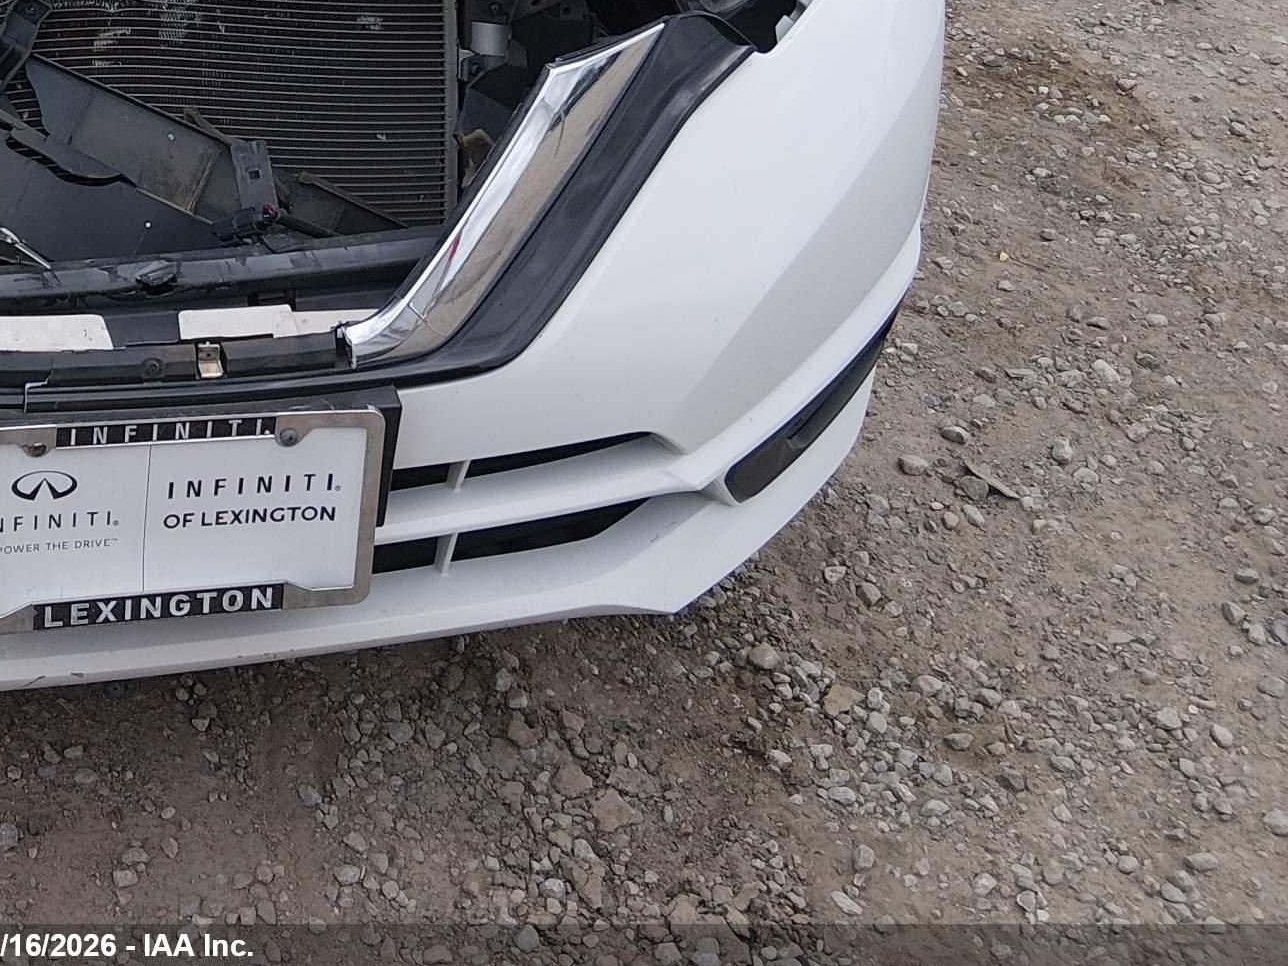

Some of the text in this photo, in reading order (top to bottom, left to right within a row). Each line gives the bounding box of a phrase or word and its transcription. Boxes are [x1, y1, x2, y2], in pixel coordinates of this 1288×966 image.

[70, 418, 262, 446] INFINITI
[168, 473, 334, 500] INFINITI
[163, 506, 337, 529] OF LEXINGTON
[44, 540, 70, 552] THE
[73, 538, 112, 550] DRIVE
[44, 587, 273, 629] LEXINGTON
